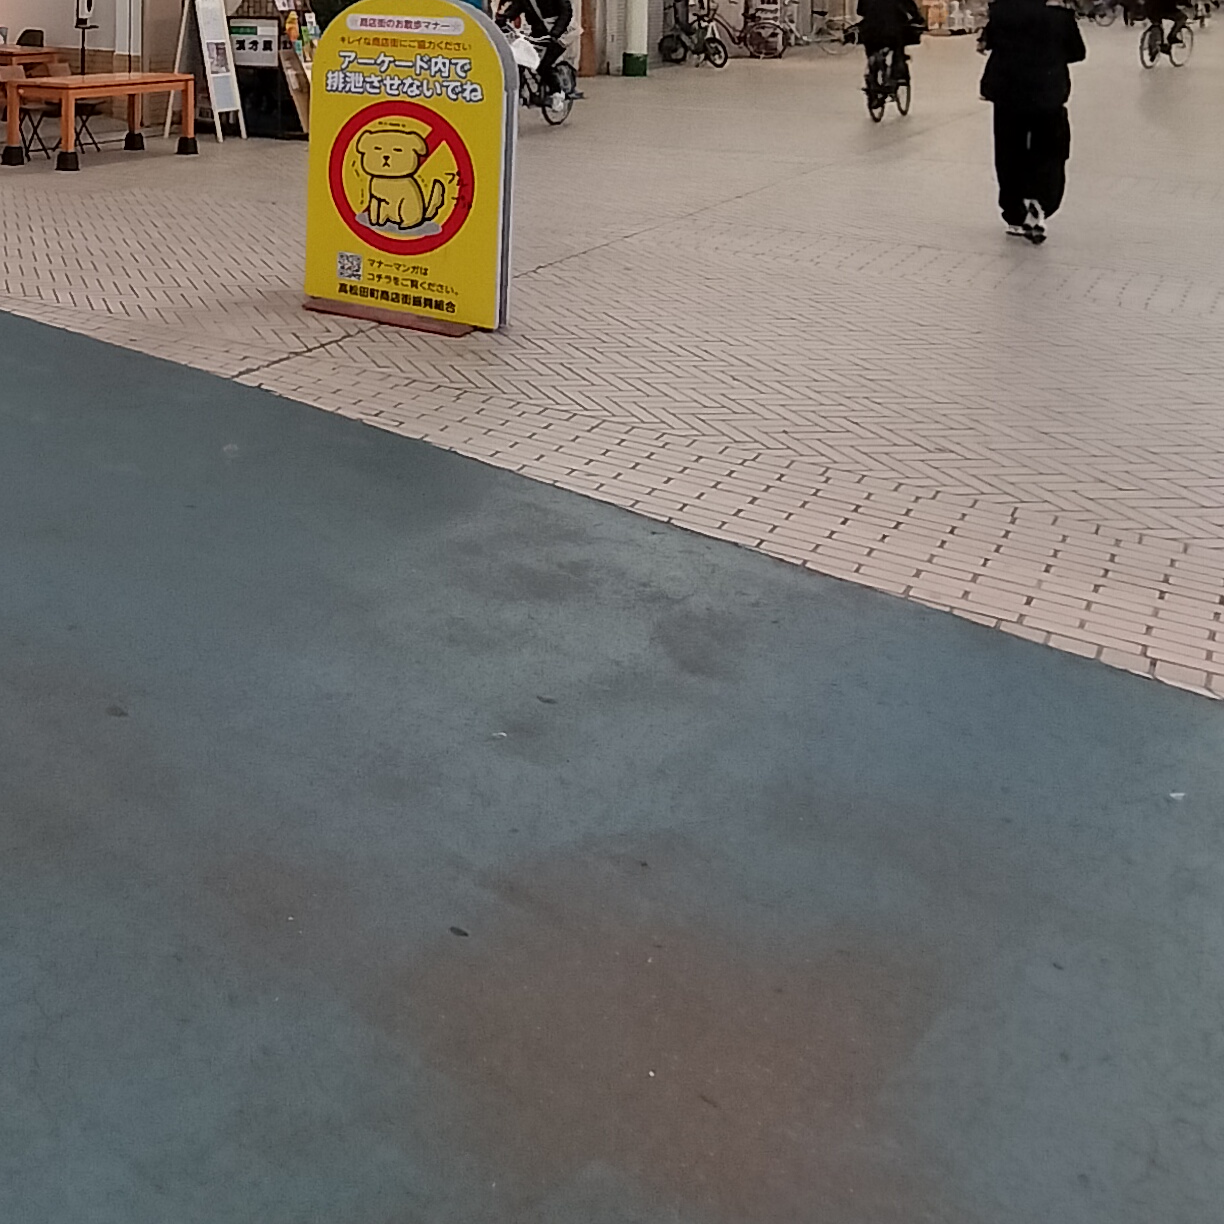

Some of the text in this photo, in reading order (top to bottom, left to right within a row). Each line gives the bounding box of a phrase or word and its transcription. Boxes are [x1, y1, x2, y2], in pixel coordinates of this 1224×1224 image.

[359, 17, 451, 31] 商店街のお散歩マナー
[338, 50, 472, 78] アーケード内で
[326, 70, 484, 103] 排泄させないでね
[367, 258, 429, 276] マナーマンガは
[367, 272, 459, 296] コチラをご覧ください。
[338, 282, 456, 314] 高松田町商店街振興組合
